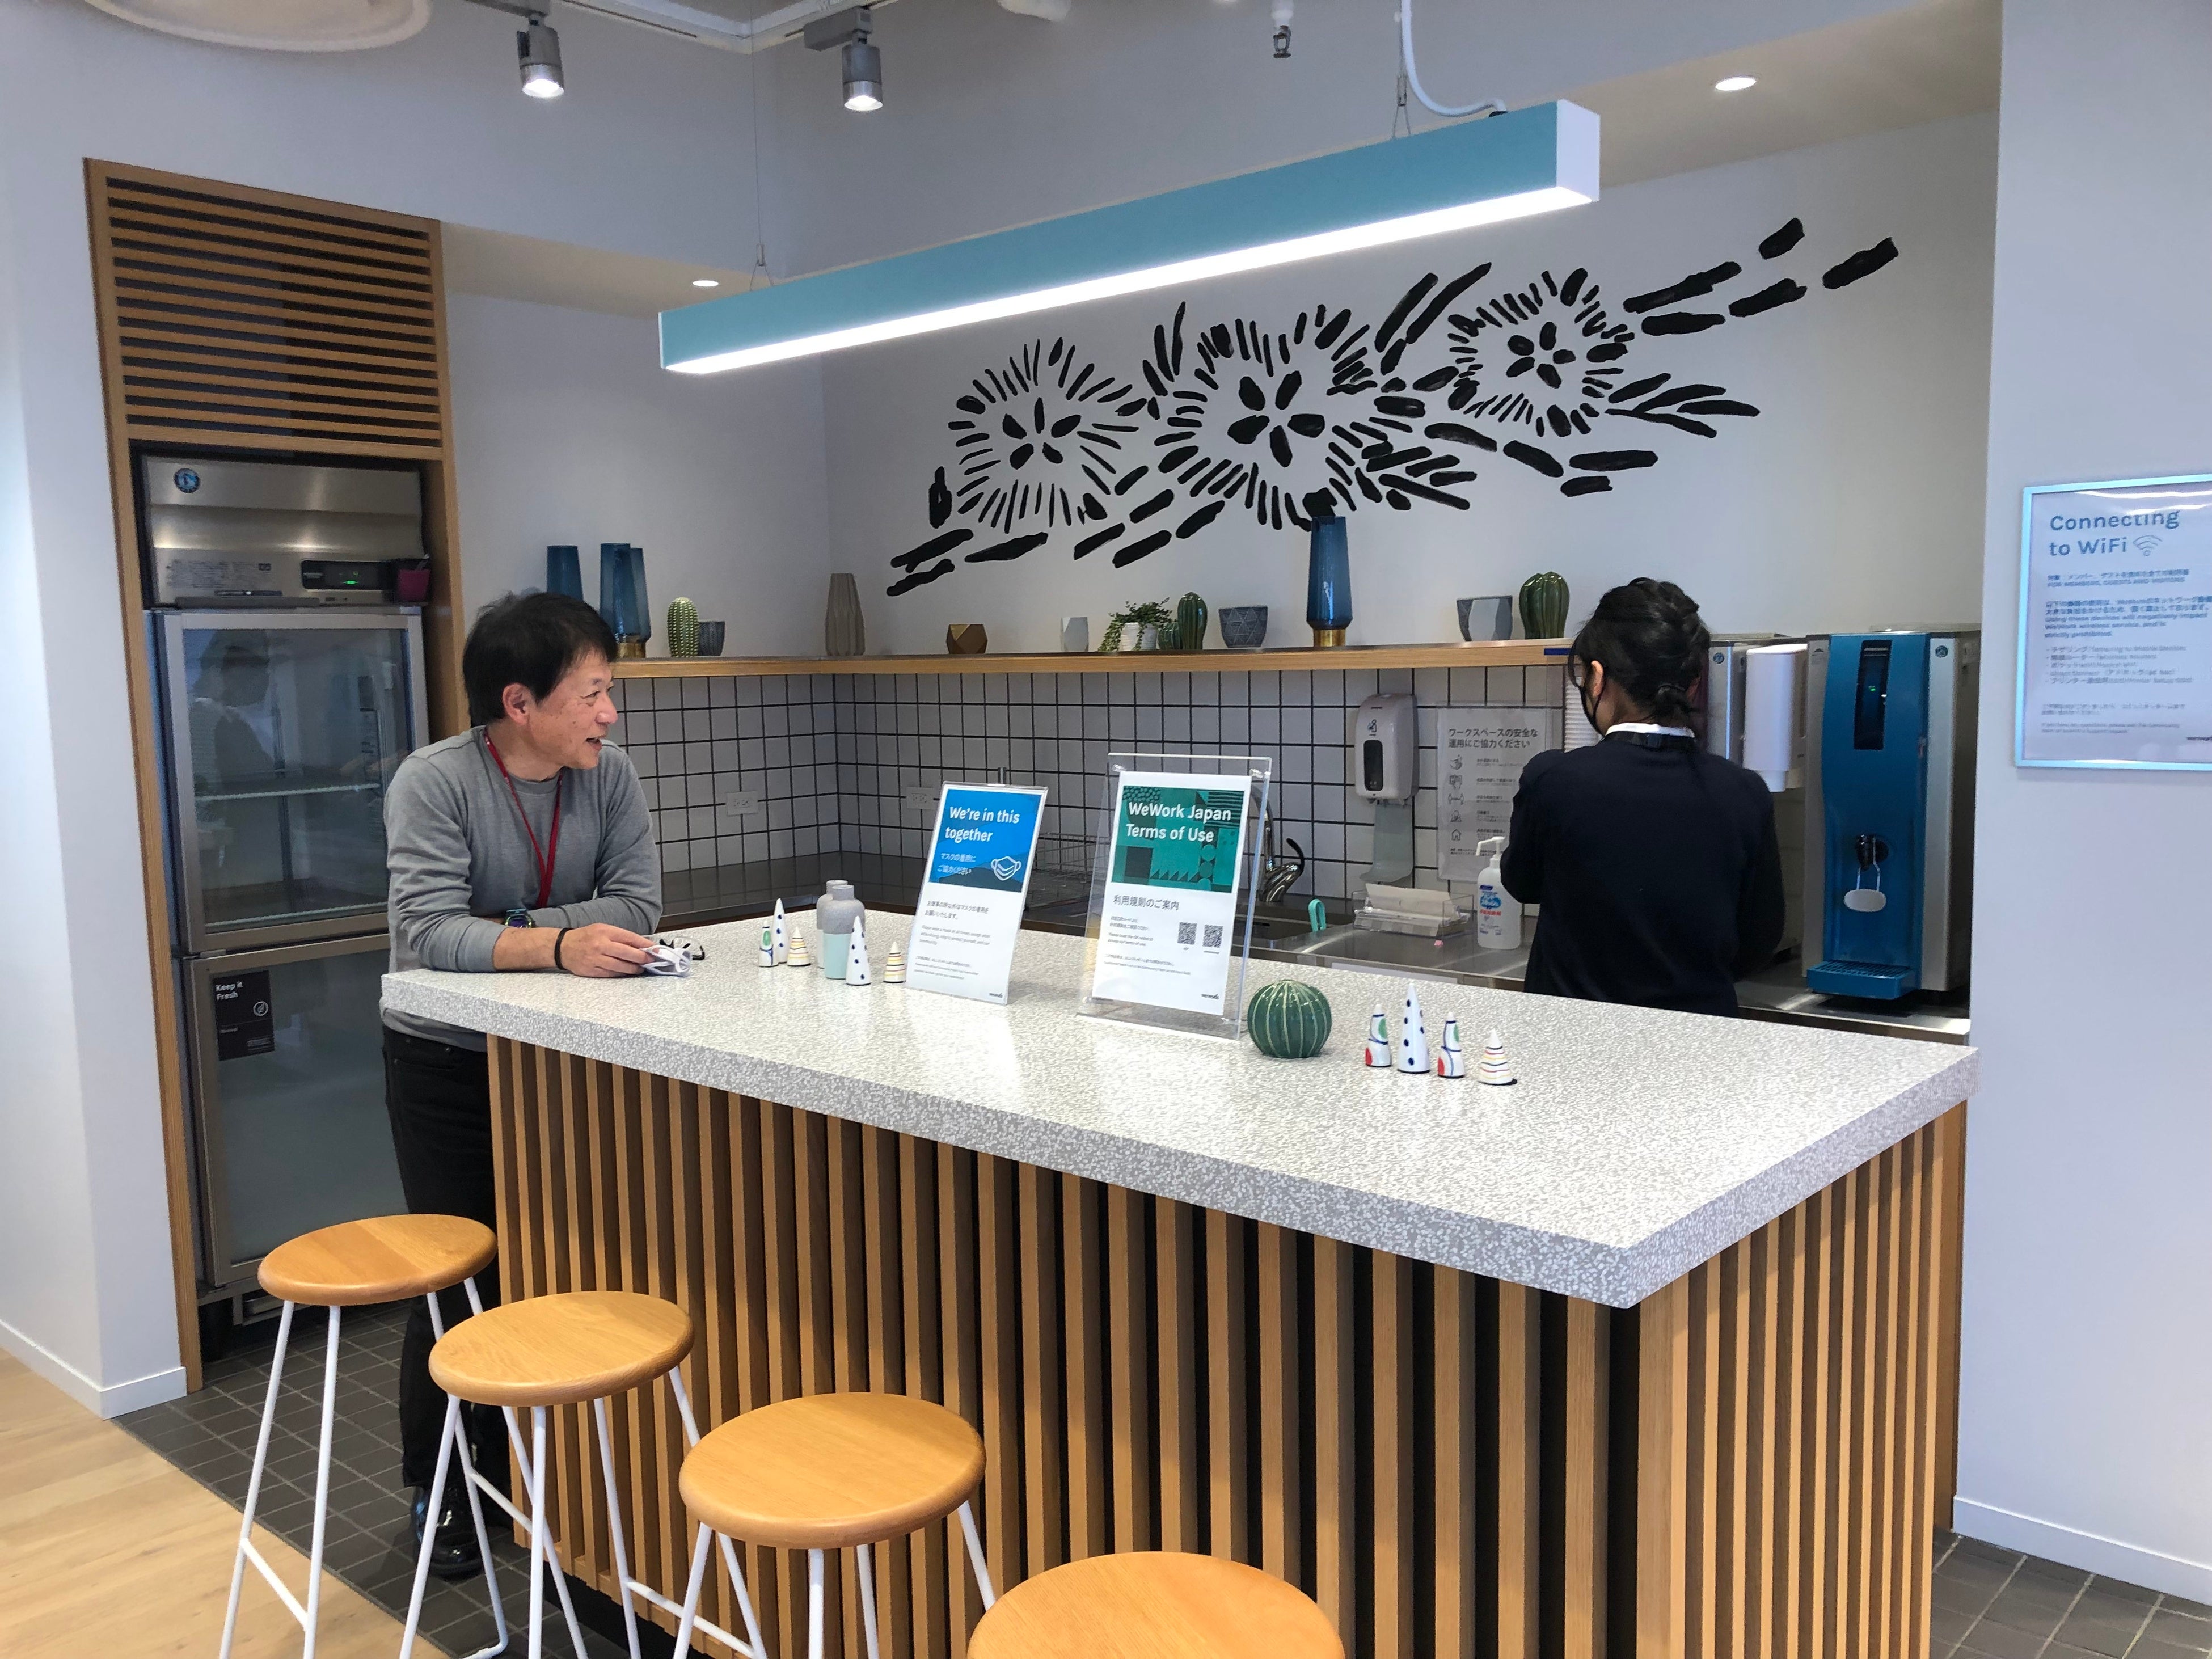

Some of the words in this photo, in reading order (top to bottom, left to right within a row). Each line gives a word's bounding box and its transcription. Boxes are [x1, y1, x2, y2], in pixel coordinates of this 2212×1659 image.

[2050, 510, 2180, 531] Connecting
[2049, 542, 2071, 556] to
[2078, 537, 2127, 554] WiFi
[1449, 727, 1538, 738] ワークスペースの安全な
[1448, 738, 1530, 749] 運用にご協力ください
[982, 808, 994, 822] in
[997, 809, 1020, 824] this
[1129, 801, 1185, 818] WeWork
[1187, 804, 1231, 824] Japan
[945, 827, 993, 843] together
[1126, 823, 1167, 840] Terms
[1170, 826, 1186, 841] of
[1188, 828, 1214, 843] Use
[1113, 894, 1180, 911] 利用規則のご案内
[216, 983, 236, 992] Keep
[217, 991, 238, 1001] Fresh
